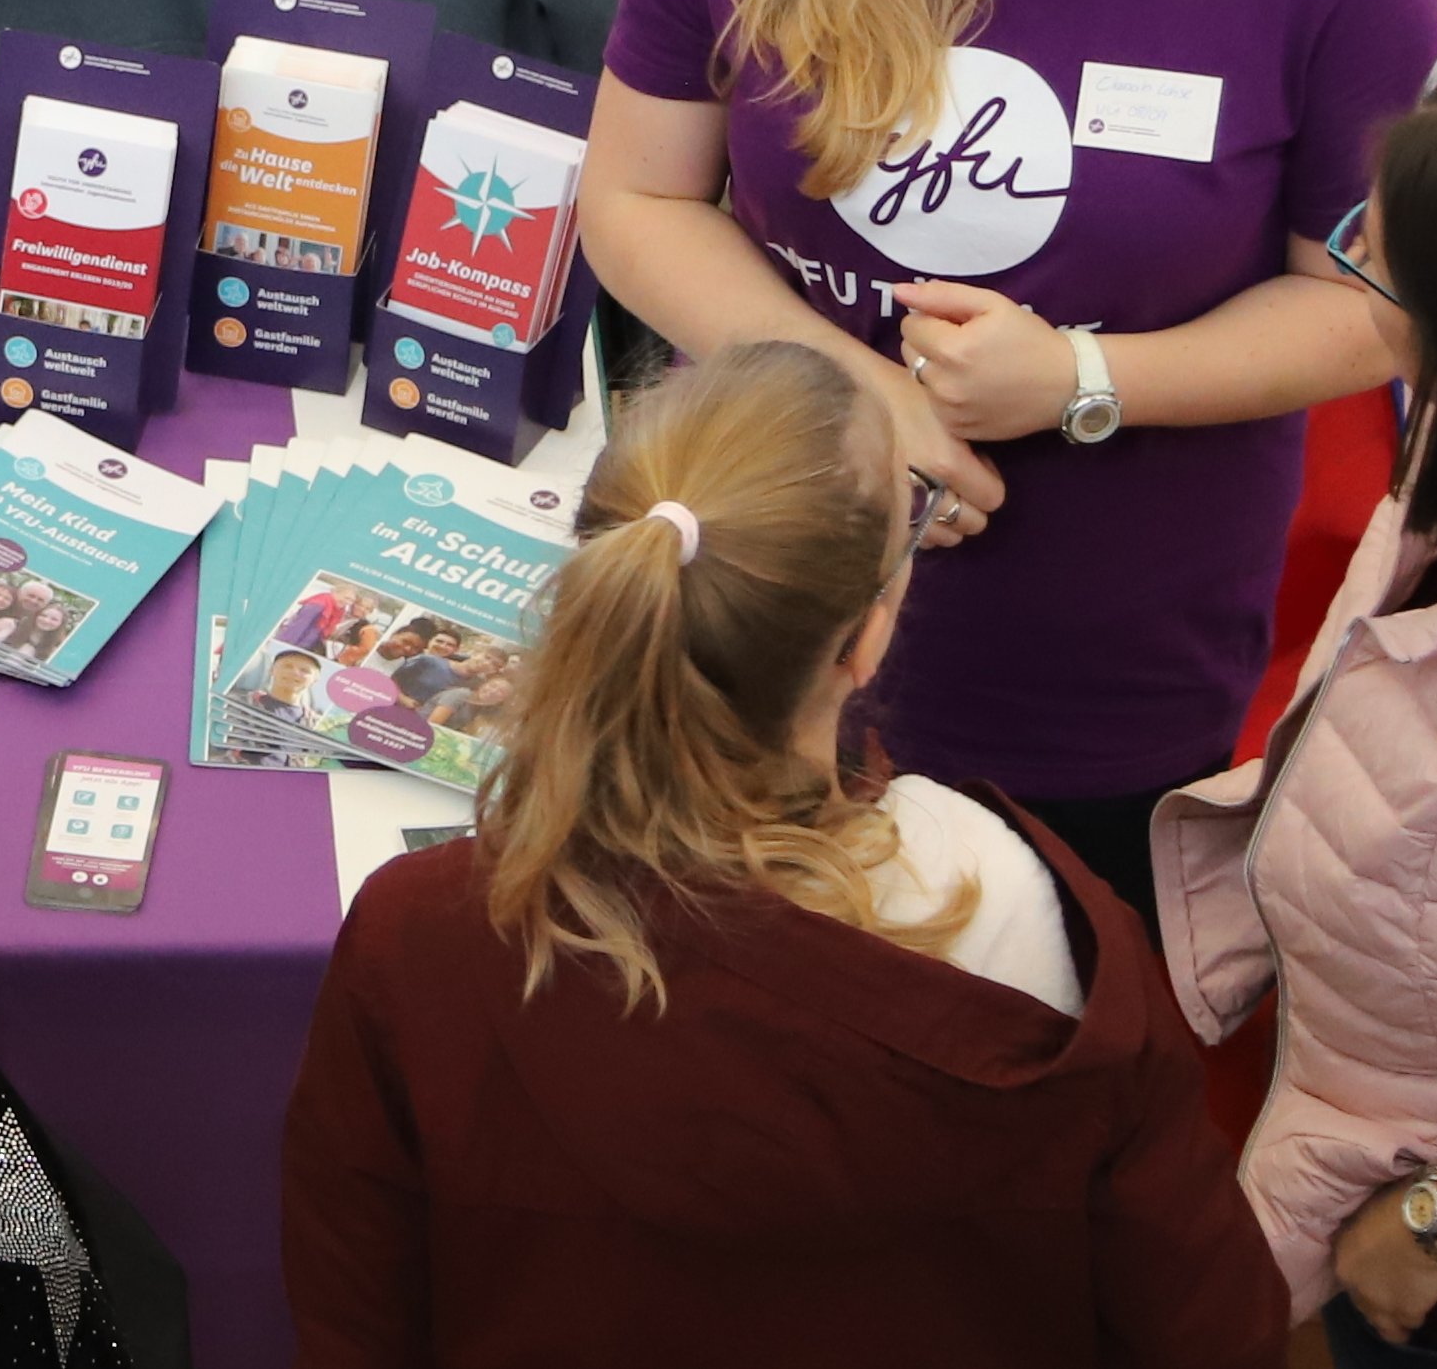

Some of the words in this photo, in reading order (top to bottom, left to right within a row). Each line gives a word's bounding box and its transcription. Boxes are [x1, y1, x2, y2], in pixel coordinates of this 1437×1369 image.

[235, 149, 248, 160] Zu
[250, 148, 312, 173] Hause
[220, 160, 238, 173] die
[240, 166, 293, 192] Welt
[296, 178, 357, 197] entdecken
[12, 238, 148, 276] Freiwilligendienst
[406, 247, 531, 299] Job-Kompass
[257, 287, 320, 307] Austausch
[257, 299, 309, 316] weltweit
[254, 340, 298, 354] werden
[255, 328, 321, 348] Gastfamilie
[45, 348, 107, 368] Austausch
[431, 352, 490, 379] Austausch
[44, 361, 96, 378] weltweit
[430, 364, 480, 387] weltweit
[41, 389, 107, 410] Gastfamilie
[41, 400, 84, 416] werden
[426, 391, 489, 420] Gastfamilie
[426, 404, 468, 424] werden
[0, 481, 55, 518] Mein
[59, 507, 117, 545] Kind
[371, 521, 400, 542] im
[402, 516, 439, 538] Ein
[3, 503, 140, 576] YFU-Austausch
[381, 541, 537, 609] Auslan
